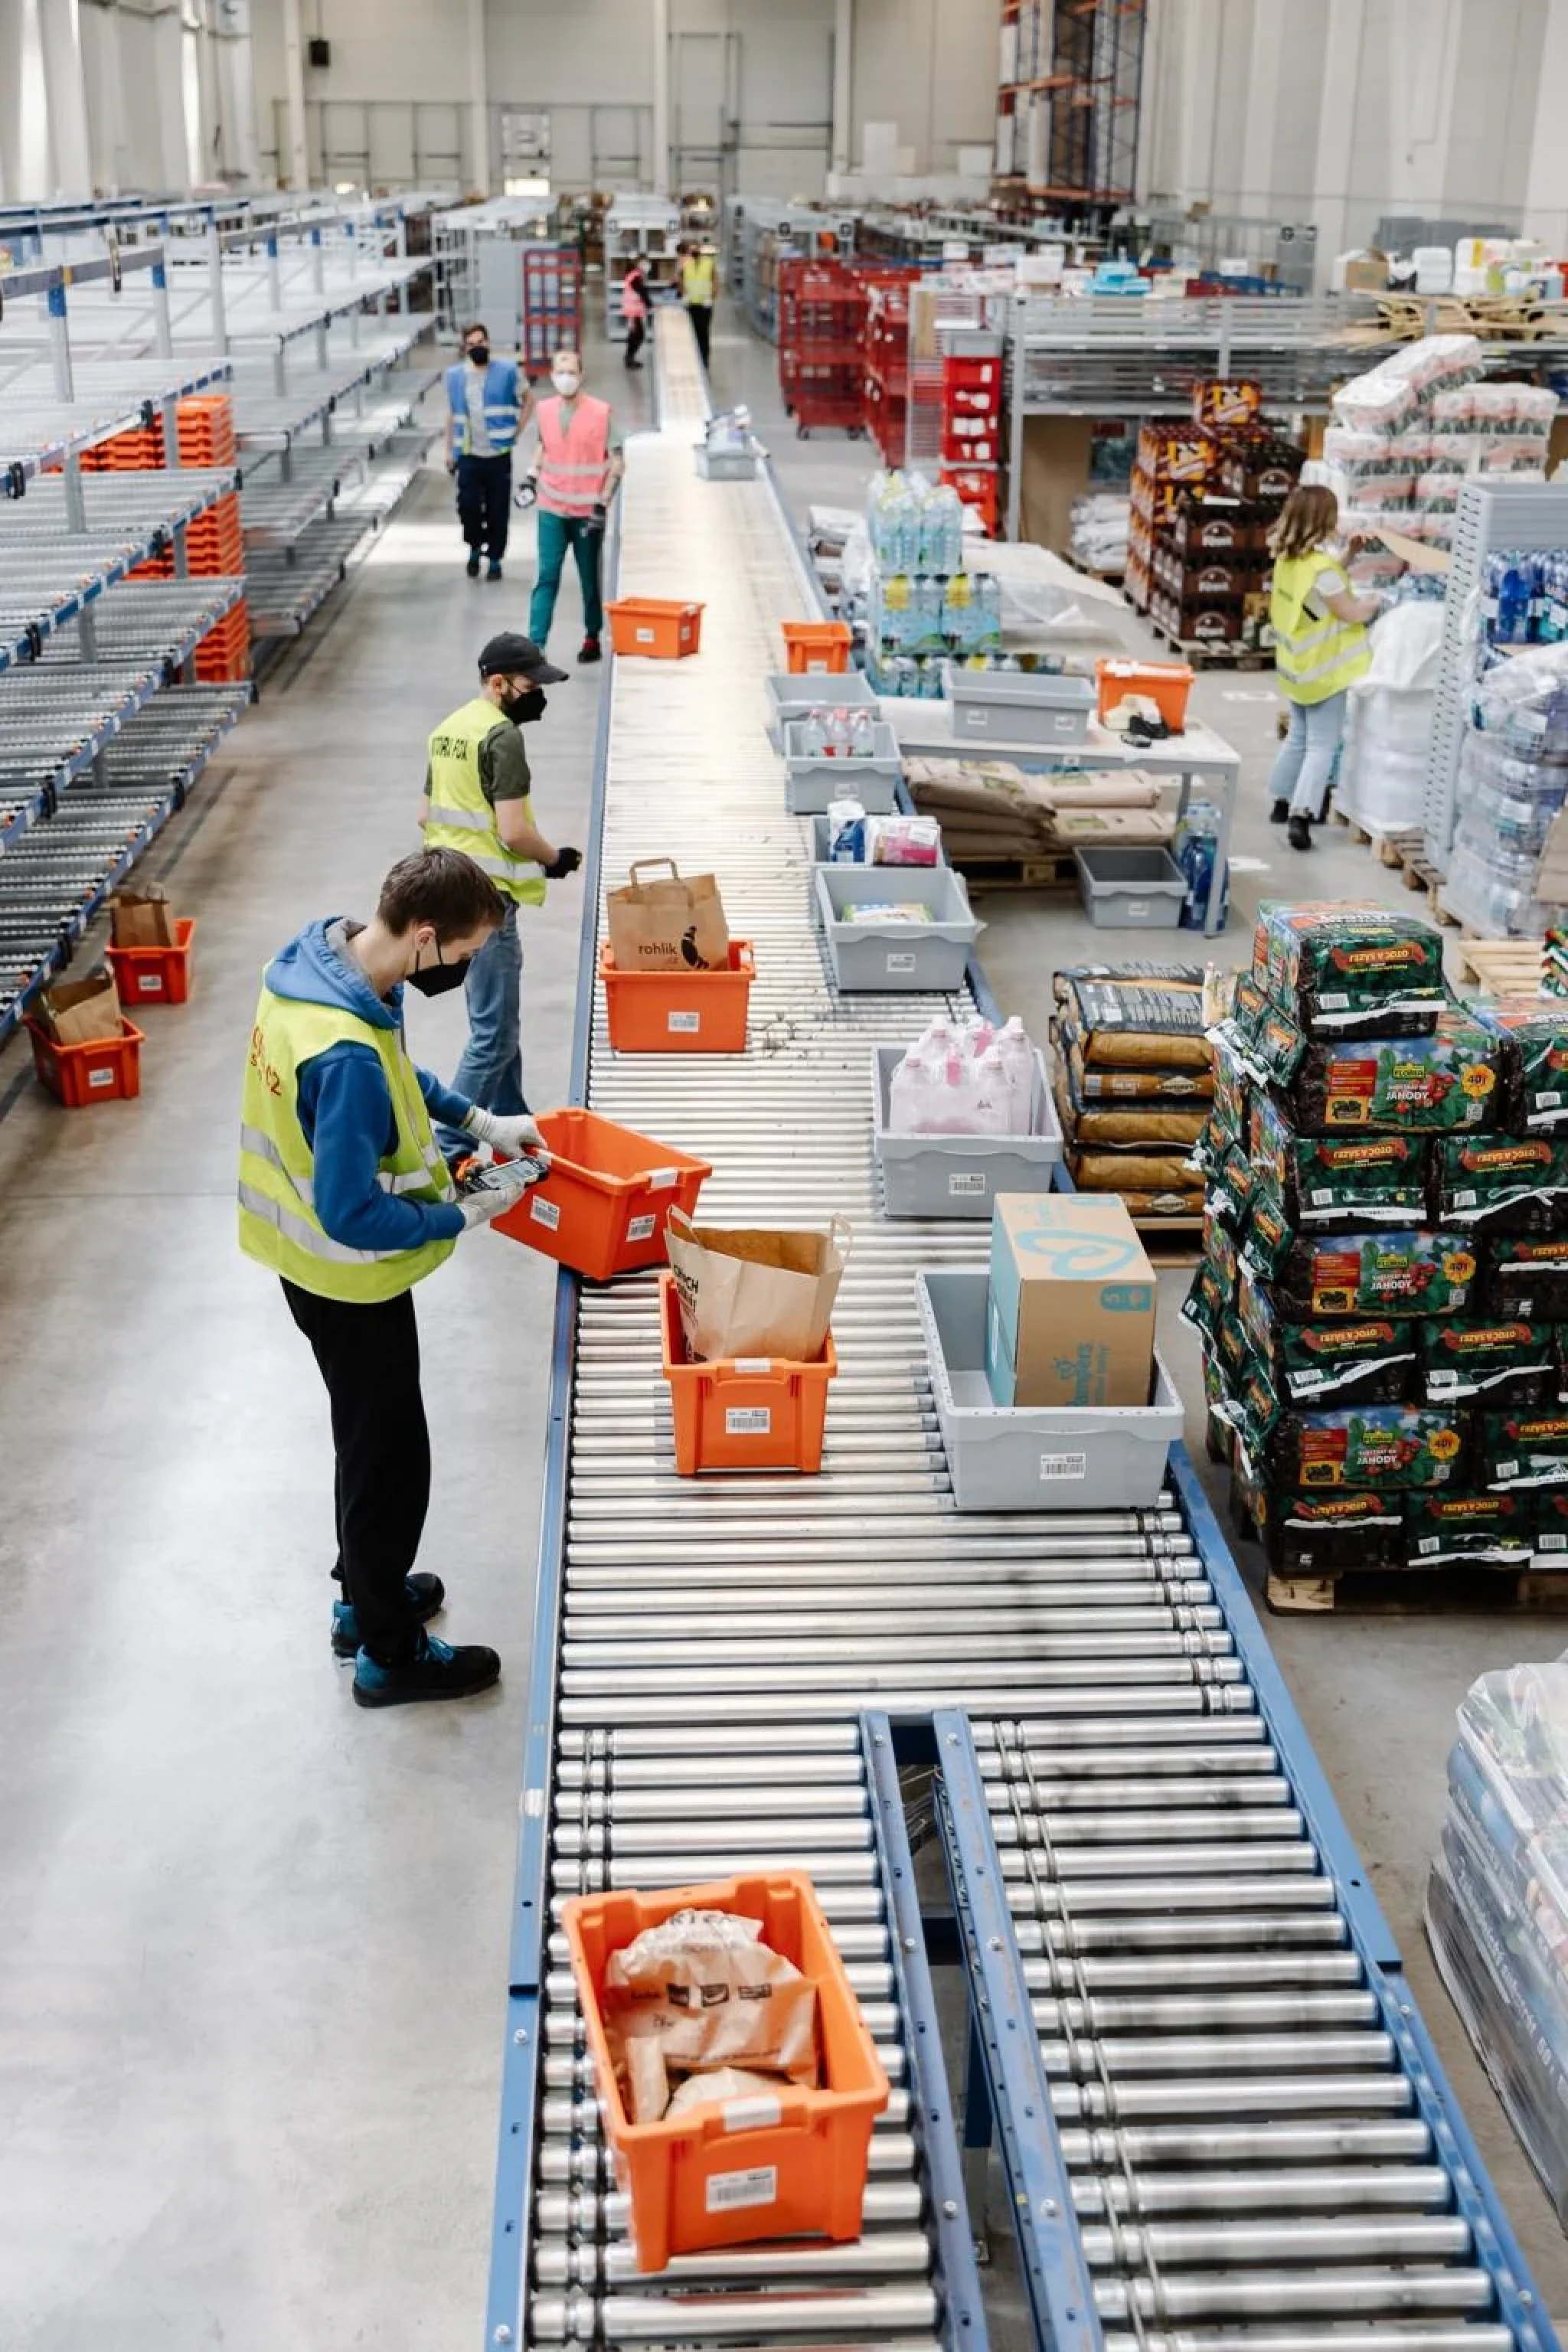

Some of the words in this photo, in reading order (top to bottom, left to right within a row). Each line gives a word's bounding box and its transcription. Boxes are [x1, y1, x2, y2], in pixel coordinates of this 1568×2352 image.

[638, 943, 678, 955] rohlik
[1386, 1091, 1429, 1100] JAHODY
[1370, 1281, 1412, 1290] JAHODY
[1357, 1455, 1396, 1465] JAHODY
